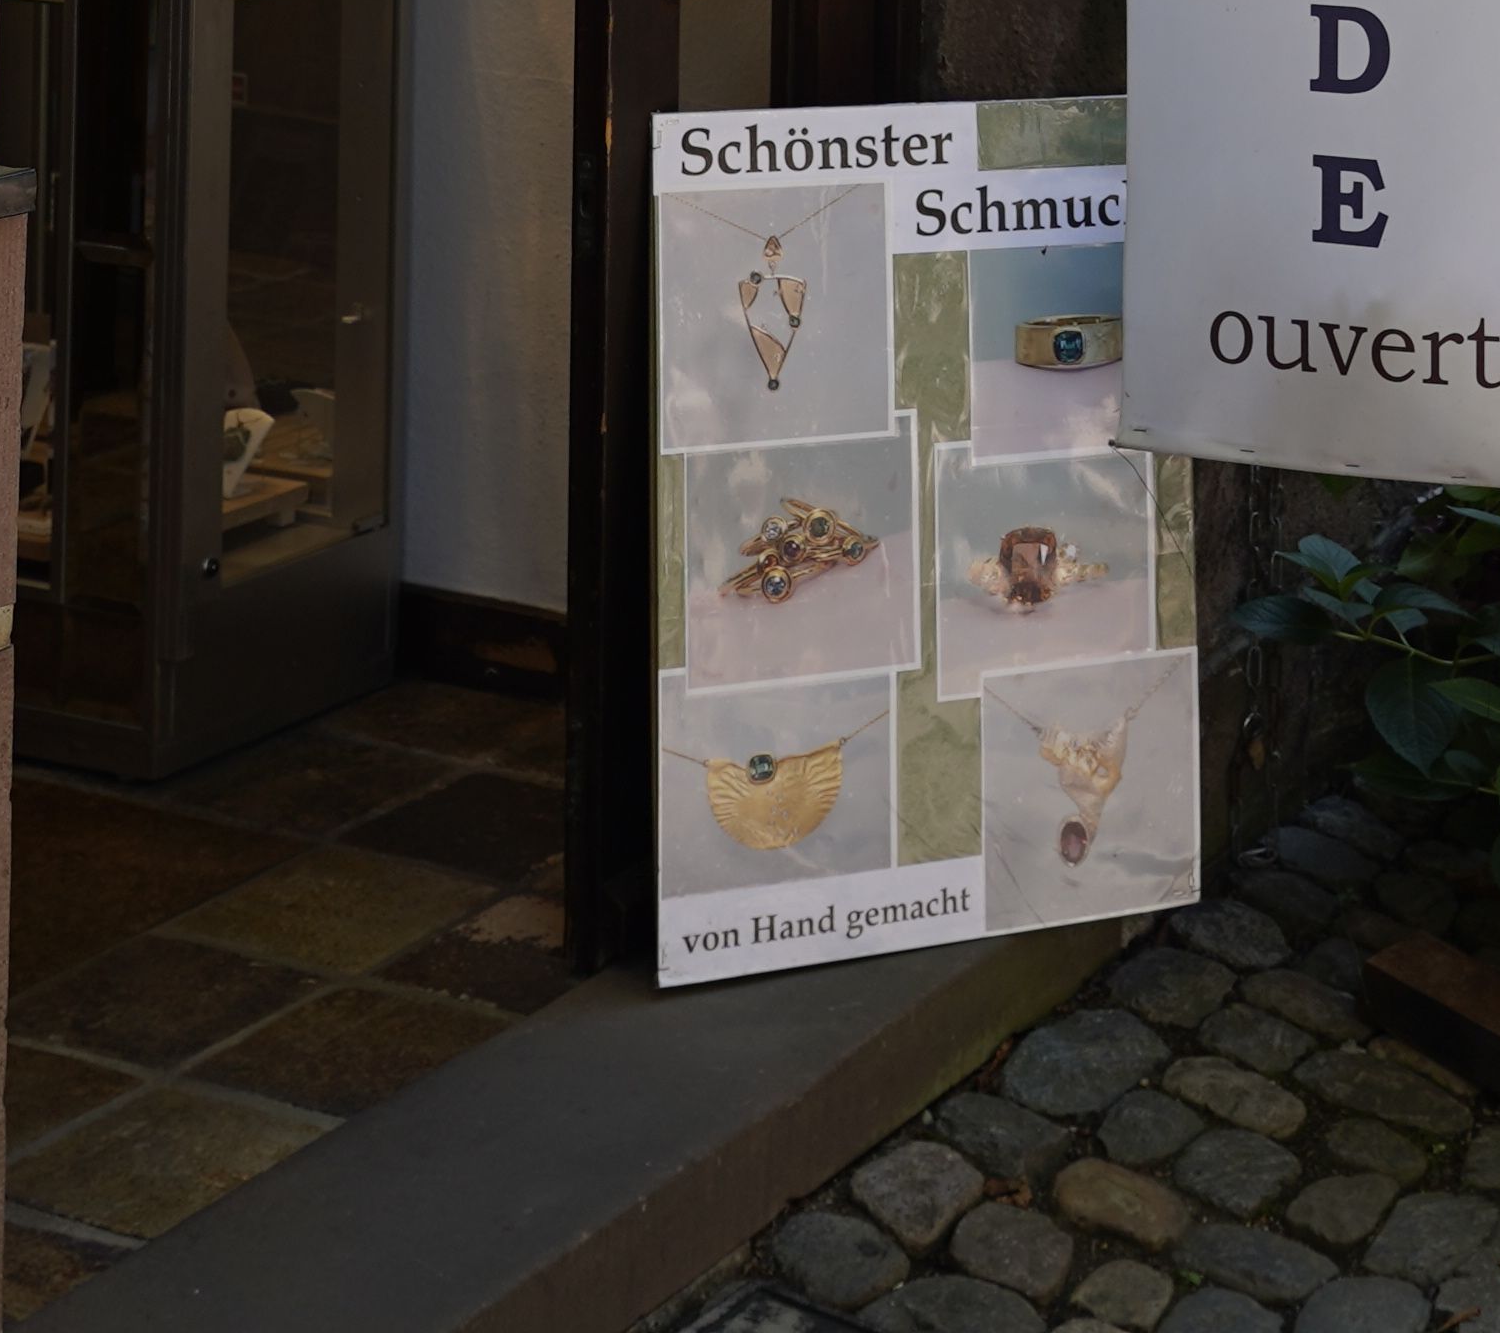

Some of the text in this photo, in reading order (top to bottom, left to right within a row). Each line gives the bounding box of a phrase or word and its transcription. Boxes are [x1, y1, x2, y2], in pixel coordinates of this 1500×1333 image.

[680, 123, 954, 176] Schönster
[915, 179, 1127, 237] Schmuc
[682, 886, 971, 954] von Hand gemacht
